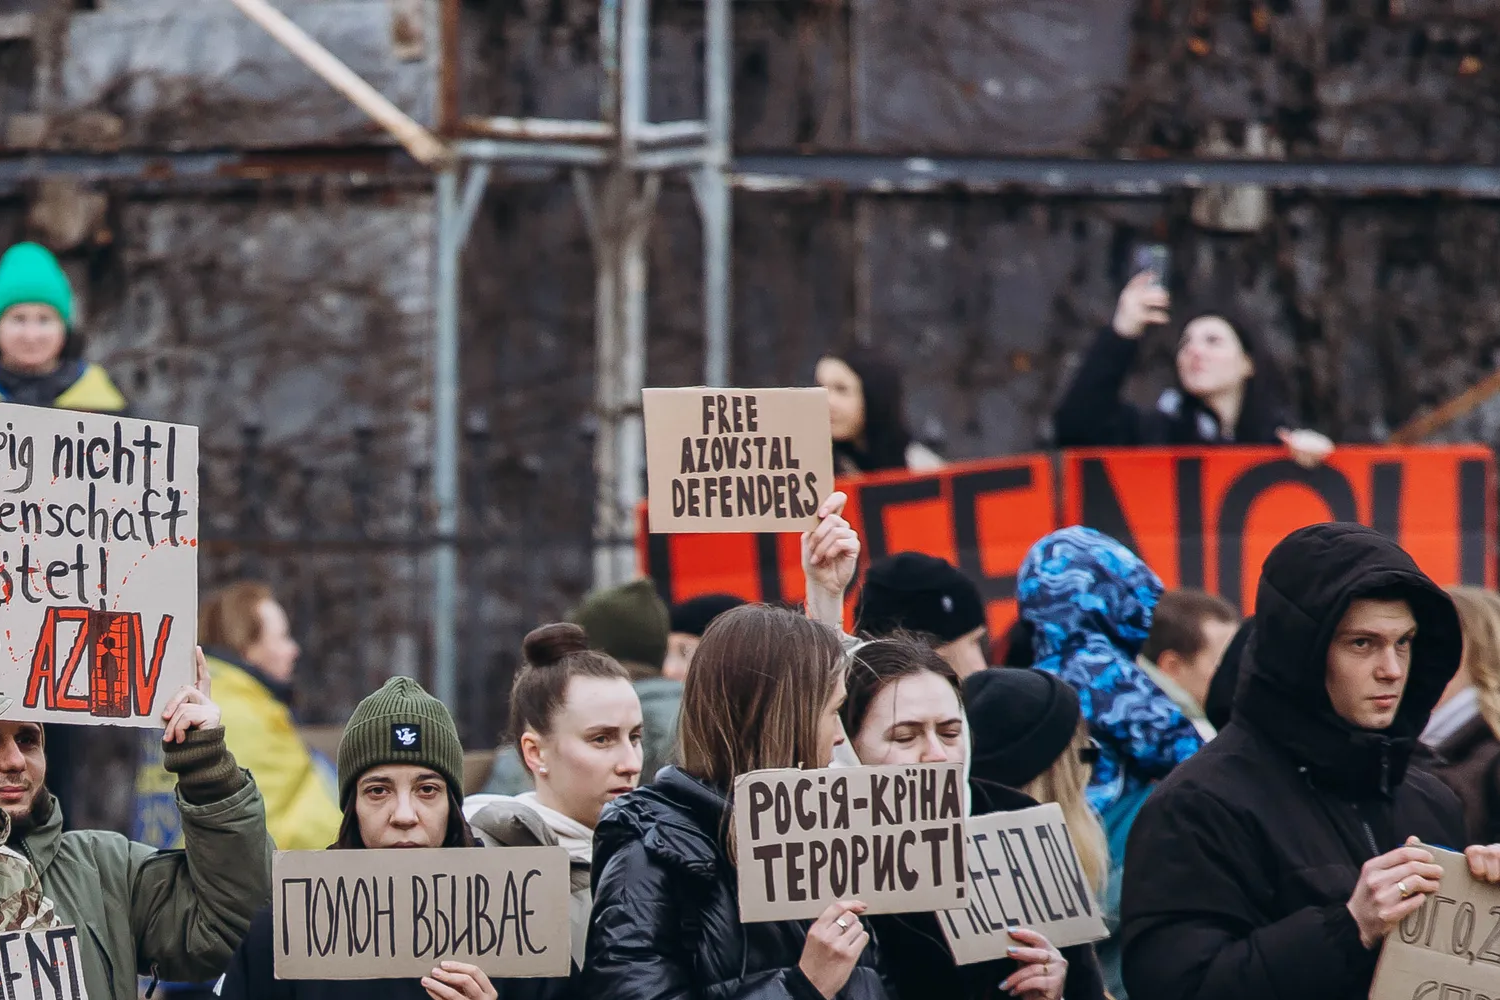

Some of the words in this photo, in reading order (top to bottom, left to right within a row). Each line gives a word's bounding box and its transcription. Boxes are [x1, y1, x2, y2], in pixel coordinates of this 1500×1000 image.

[702, 394, 758, 435] FREE
[680, 436, 799, 474] AZOVSTAL
[672, 472, 819, 518] DEFENDERS
[23, 606, 174, 718] AZOV
[753, 823, 965, 902] ТЕРОРИСТ!
[997, 823, 1092, 924] AZOV
[282, 875, 396, 957] ПОЛОН
[412, 869, 548, 960] ВБИВАЄ
